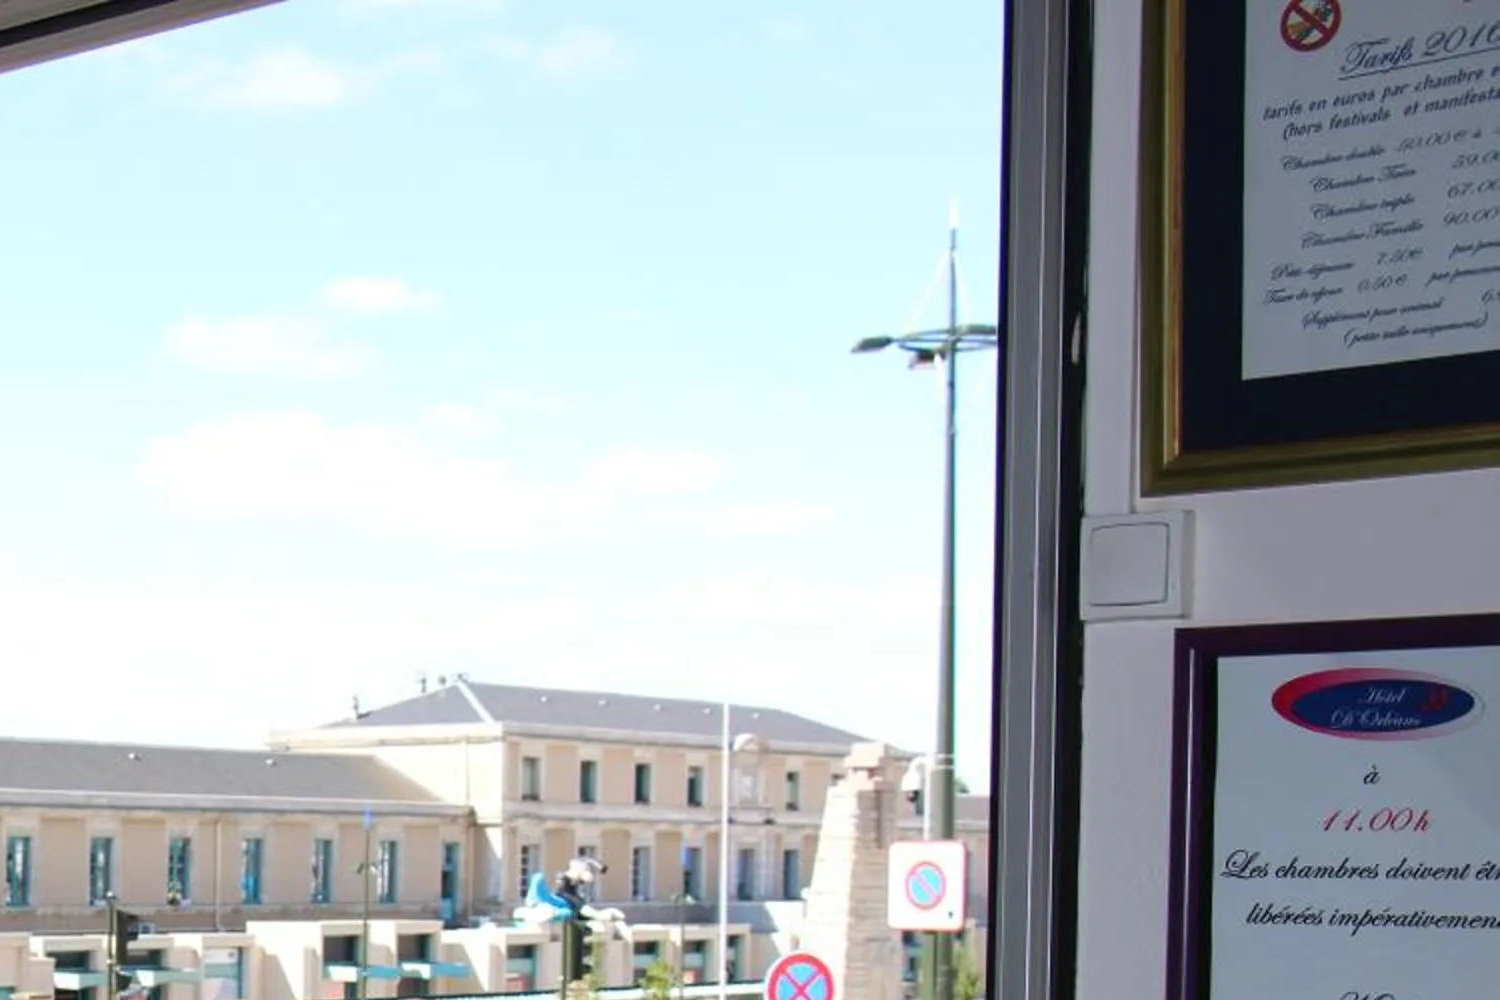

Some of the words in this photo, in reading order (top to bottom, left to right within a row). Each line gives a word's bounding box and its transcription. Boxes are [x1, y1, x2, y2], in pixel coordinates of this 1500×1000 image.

[1262, 99, 1303, 121] tarifs
[1308, 99, 1327, 112] en
[1332, 91, 1375, 107] euros
[1380, 83, 1409, 104] par
[1414, 68, 1484, 91] chambre
[1329, 106, 1391, 131] festivals
[1403, 101, 1419, 117] et
[1363, 764, 1381, 785] à
[1220, 849, 1269, 880] Les
[1274, 855, 1379, 880] chambres
[1385, 857, 1471, 881] doivent
[1246, 902, 1324, 926] libérées
